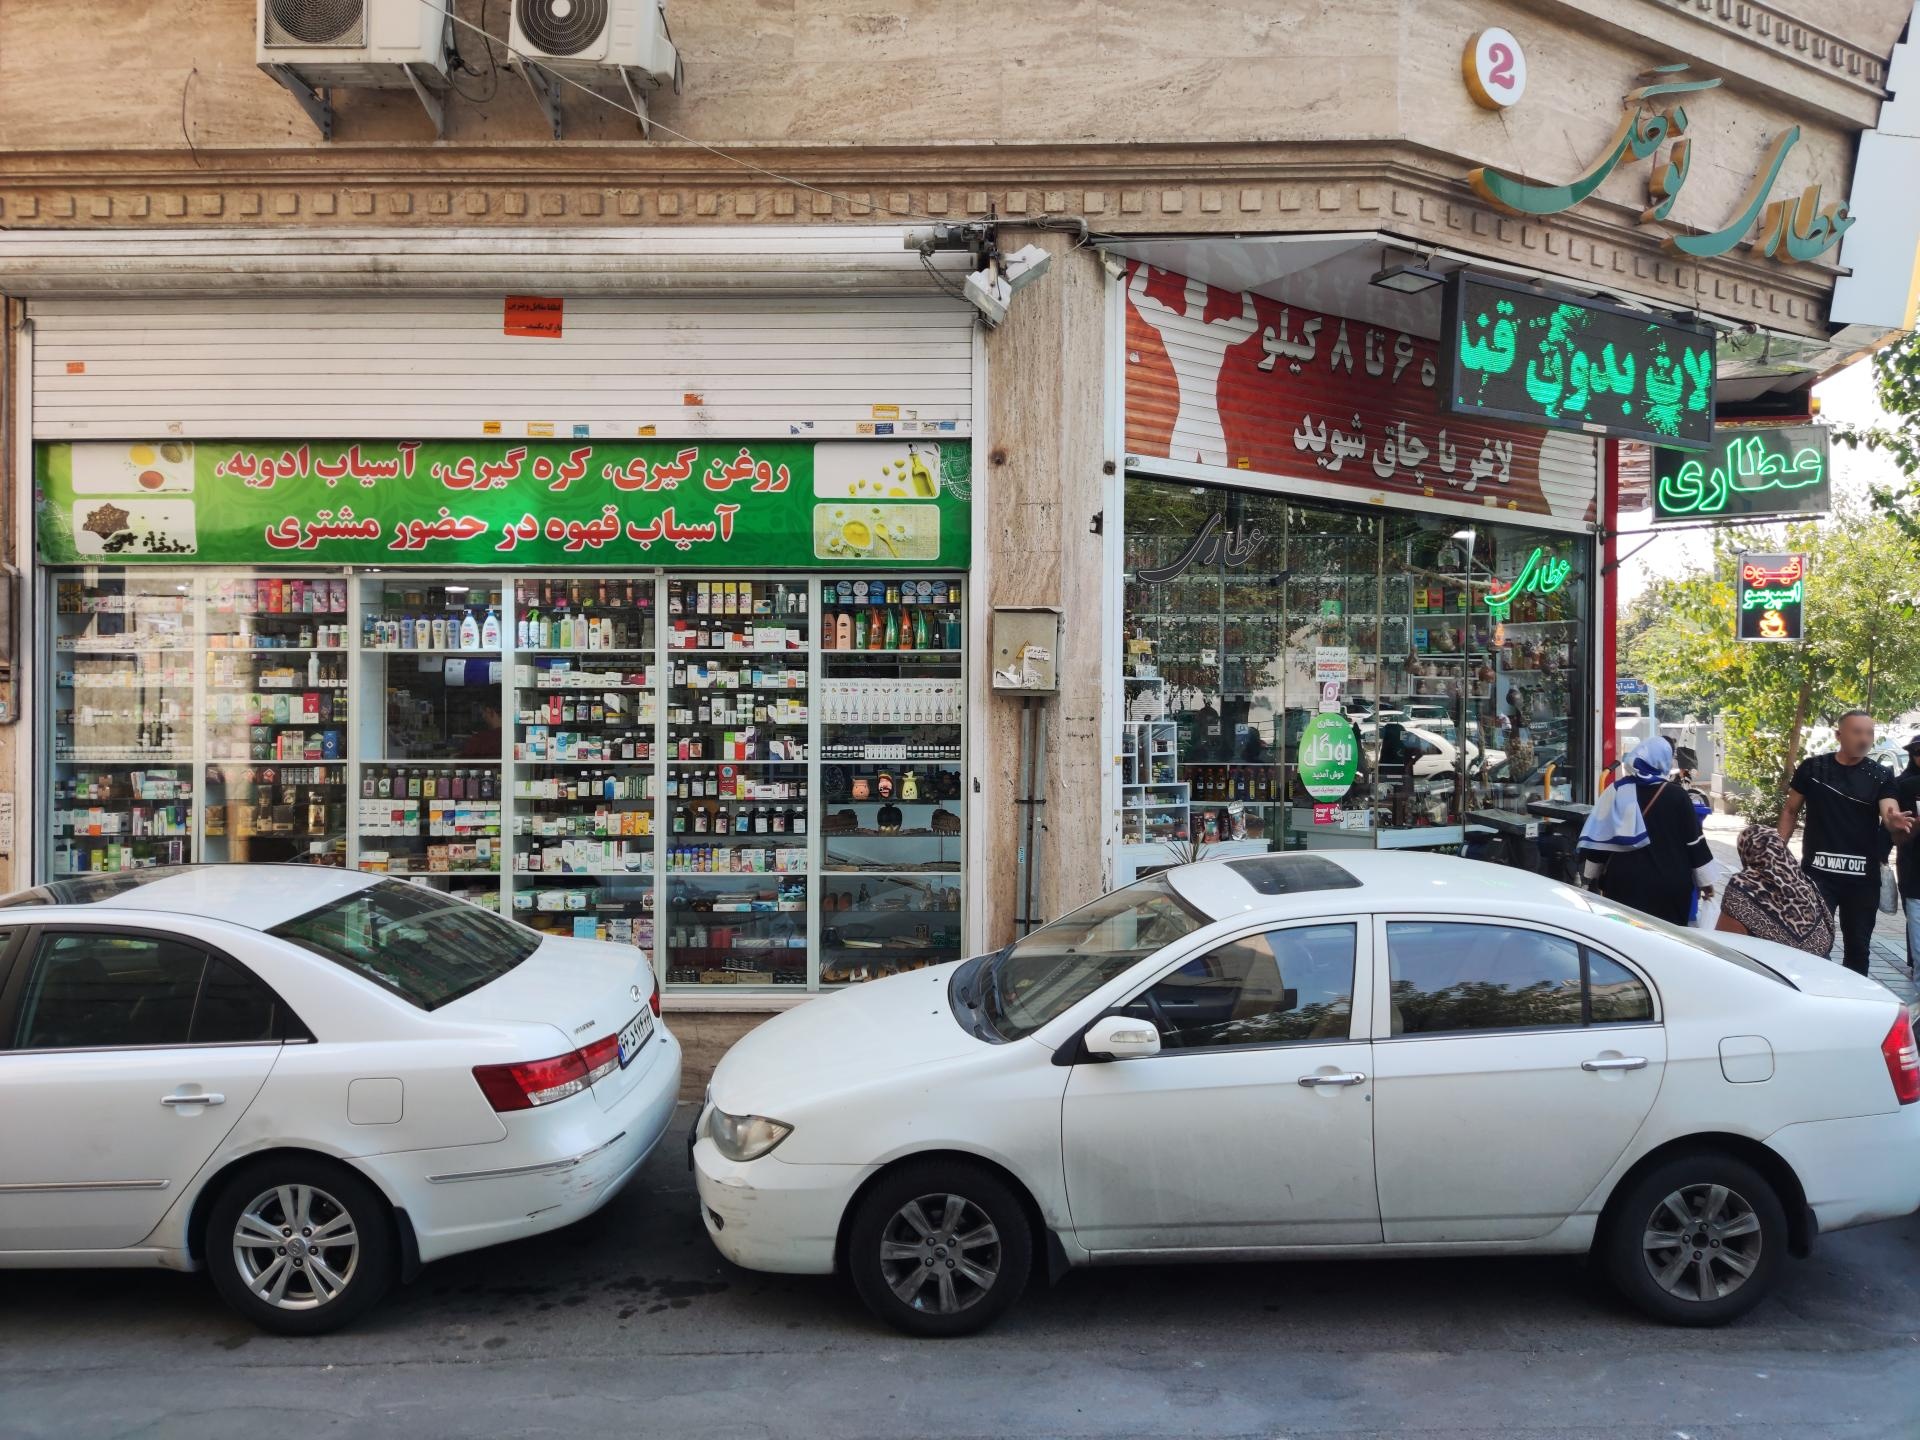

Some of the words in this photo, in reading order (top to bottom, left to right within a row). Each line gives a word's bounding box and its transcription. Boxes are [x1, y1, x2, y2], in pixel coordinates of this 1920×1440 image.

[1488, 43, 1515, 90] 2
[1257, 307, 1323, 374] کیلو
[1331, 318, 1354, 375] ۸
[1365, 328, 1385, 377] تا
[1393, 333, 1414, 385] ۶
[315, 442, 423, 488] آسیاب
[1293, 412, 1367, 473] شوید
[1371, 422, 1429, 485] چاق
[1438, 427, 1457, 487] یا
[1463, 436, 1513, 493] لاغر
[215, 444, 310, 489] ادویه،
[430, 446, 527, 492] گیری،
[533, 446, 592, 492] کره
[602, 446, 699, 491] گیری،
[702, 447, 791, 493] روغن
[1658, 435, 1823, 513] عطاری
[265, 505, 381, 550] مشتری
[388, 507, 489, 550] حضور
[495, 511, 538, 552] در
[545, 504, 621, 552] قهوه
[627, 503, 740, 551] آسیاب
[1138, 512, 1265, 583] عطاری
[1484, 547, 1571, 608] عطاری
[1742, 580, 1802, 611] اسپرسو
[1743, 557, 1801, 588] قهوه
[1304, 733, 1352, 767] نوگل
[1329, 770, 1344, 780] خوش
[1812, 855, 1826, 868] NO
[1827, 856, 1847, 870] WAY
[1848, 859, 1867, 872] OUT
